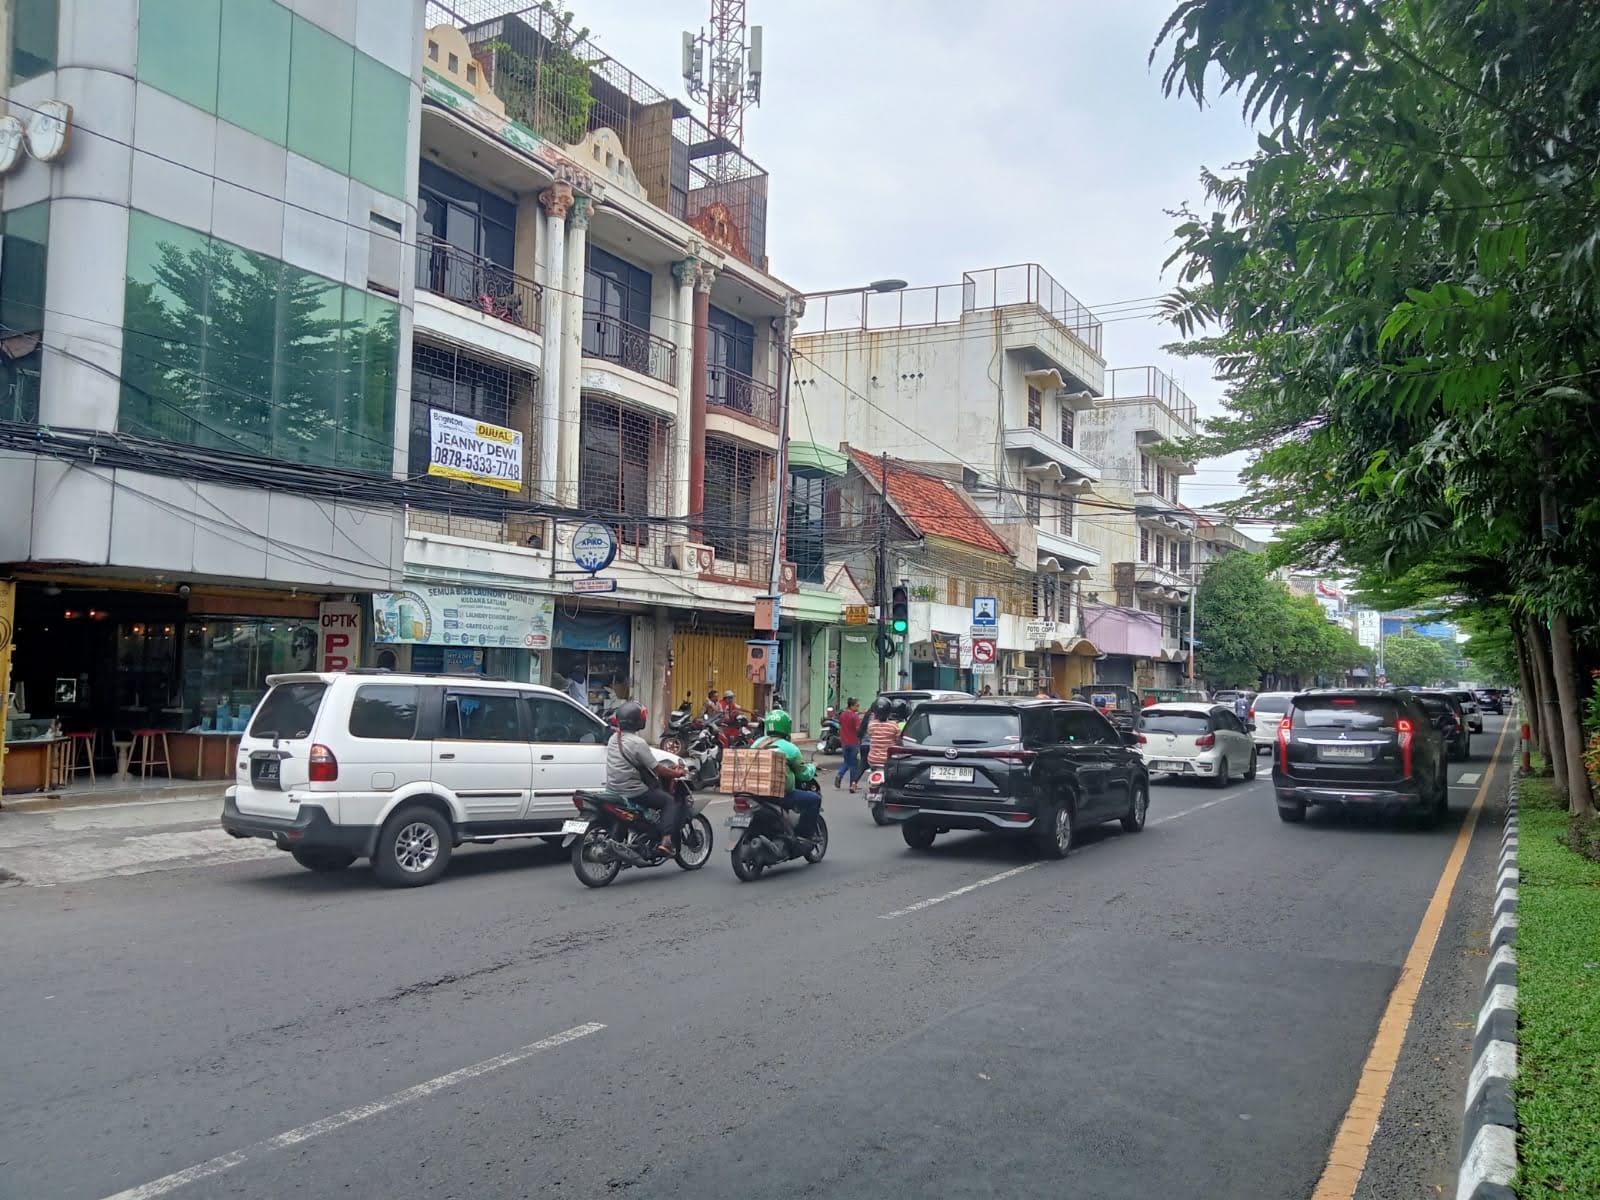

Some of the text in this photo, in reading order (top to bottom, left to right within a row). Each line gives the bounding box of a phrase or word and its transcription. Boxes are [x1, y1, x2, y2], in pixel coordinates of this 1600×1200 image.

[433, 412, 463, 427] Brighton
[478, 425, 511, 441] DIJUAL
[438, 432, 517, 461] JEANNY DEWI
[434, 446, 521, 480] 0878-5333-7748
[428, 588, 455, 597] SEMUA
[473, 588, 506, 600] LAUNDRY
[322, 614, 358, 627] OPTIK
[1027, 625, 1056, 634] FOTO COPY
